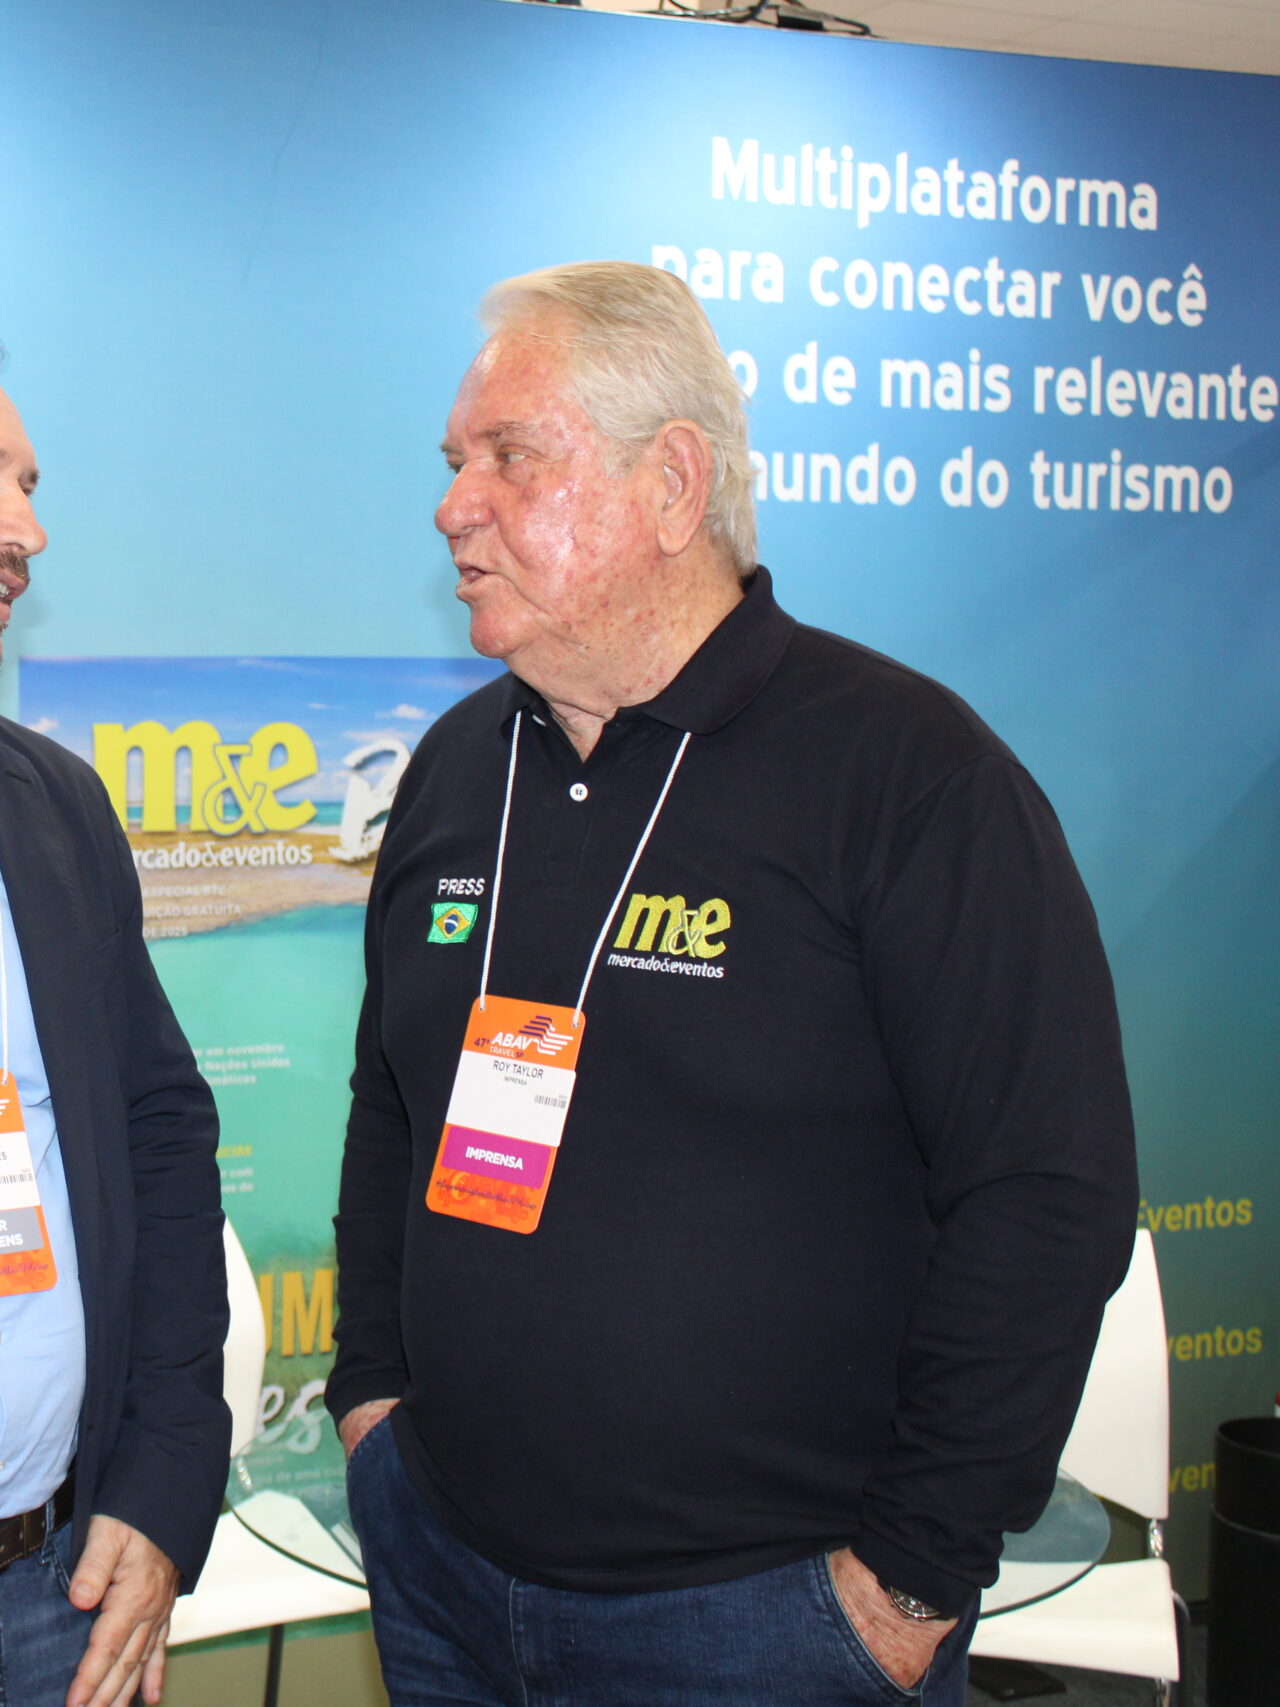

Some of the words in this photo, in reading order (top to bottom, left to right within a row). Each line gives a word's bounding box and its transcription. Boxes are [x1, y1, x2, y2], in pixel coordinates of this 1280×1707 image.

[711, 136, 1158, 230] Multiplataforma
[809, 255, 1062, 319] conectar
[1081, 263, 1208, 327] você
[783, 340, 857, 406] de
[881, 348, 1012, 413] mais
[1034, 355, 1278, 423] relevante
[939, 446, 1010, 508] do
[1029, 449, 1233, 514] turismo
[92, 720, 318, 836] m&e
[132, 840, 313, 869] rcado&eventos
[437, 878, 486, 896] PRESS
[613, 893, 731, 959] m&e
[606, 952, 725, 979] mercado&eventos
[489, 1045, 516, 1058] TRAVEL
[490, 1031, 534, 1051] ABAV
[493, 1060, 512, 1072] ROY
[513, 1063, 544, 1079] TAYLOR
[465, 1146, 524, 1170] IMPRENSA
